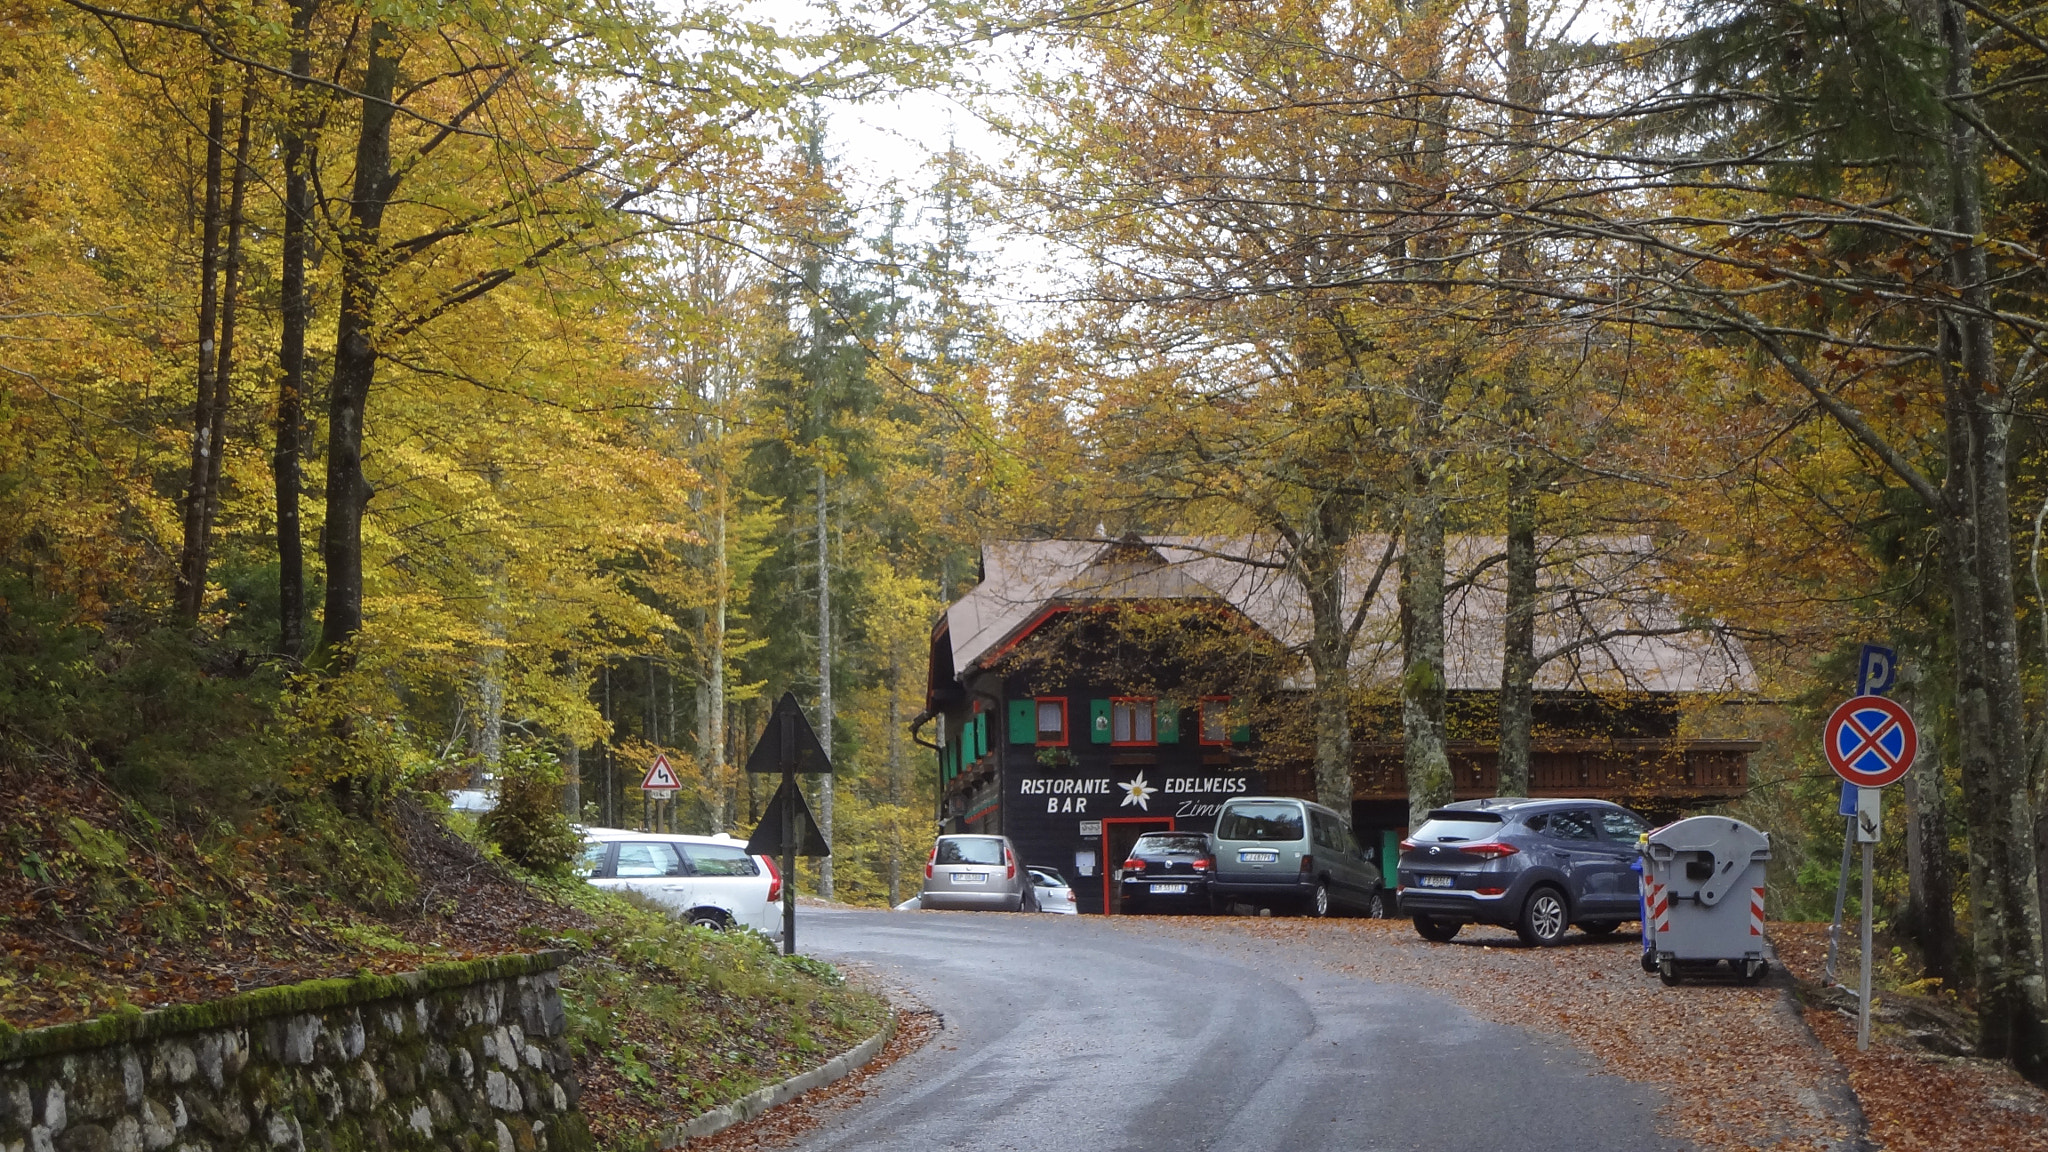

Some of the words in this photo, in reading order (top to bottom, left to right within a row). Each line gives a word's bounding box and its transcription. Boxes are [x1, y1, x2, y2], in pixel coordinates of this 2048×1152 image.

[1864, 652, 1889, 695] P
[1020, 778, 1111, 795] RISTORANTE
[1164, 777, 1247, 794] EDELWEISS
[1047, 797, 1087, 813] BAR
